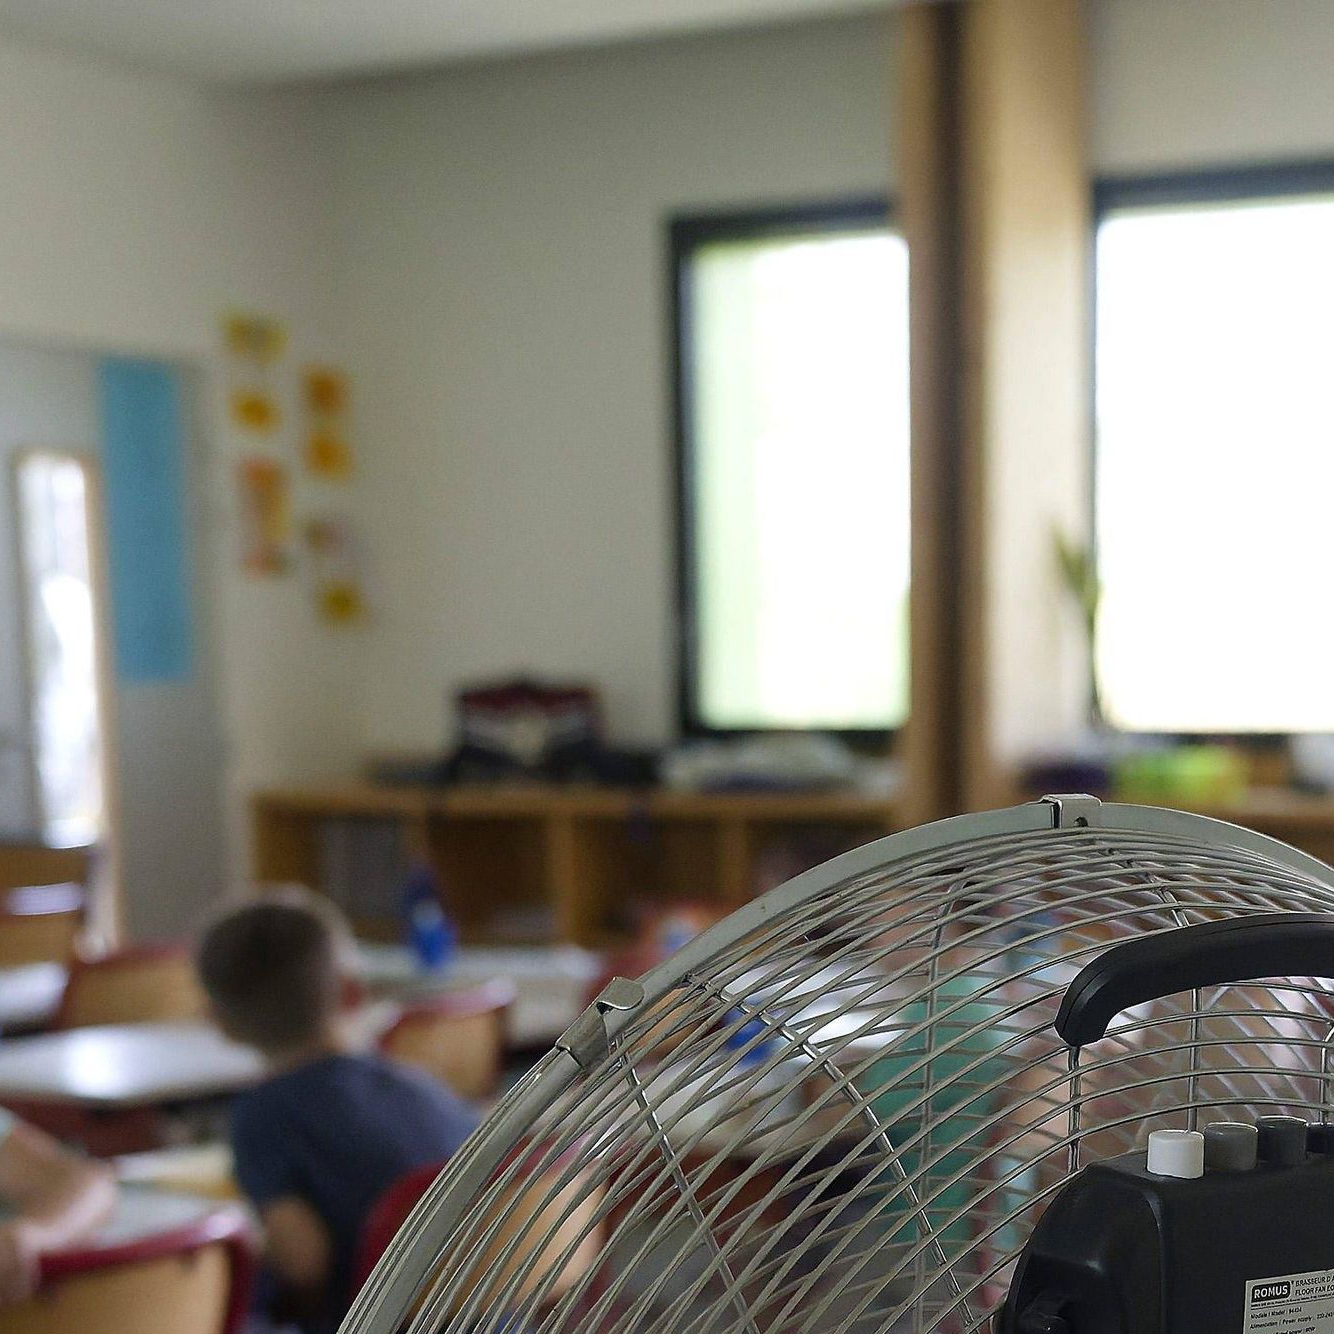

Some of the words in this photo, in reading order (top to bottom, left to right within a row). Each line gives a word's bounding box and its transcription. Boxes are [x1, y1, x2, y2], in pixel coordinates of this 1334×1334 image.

[1295, 1277, 1327, 1287] BRASSEUR
[1254, 1285, 1288, 1299] ROMUS
[1295, 1287, 1315, 1296] FLOOR
[1315, 1285, 1326, 1294] FAN
